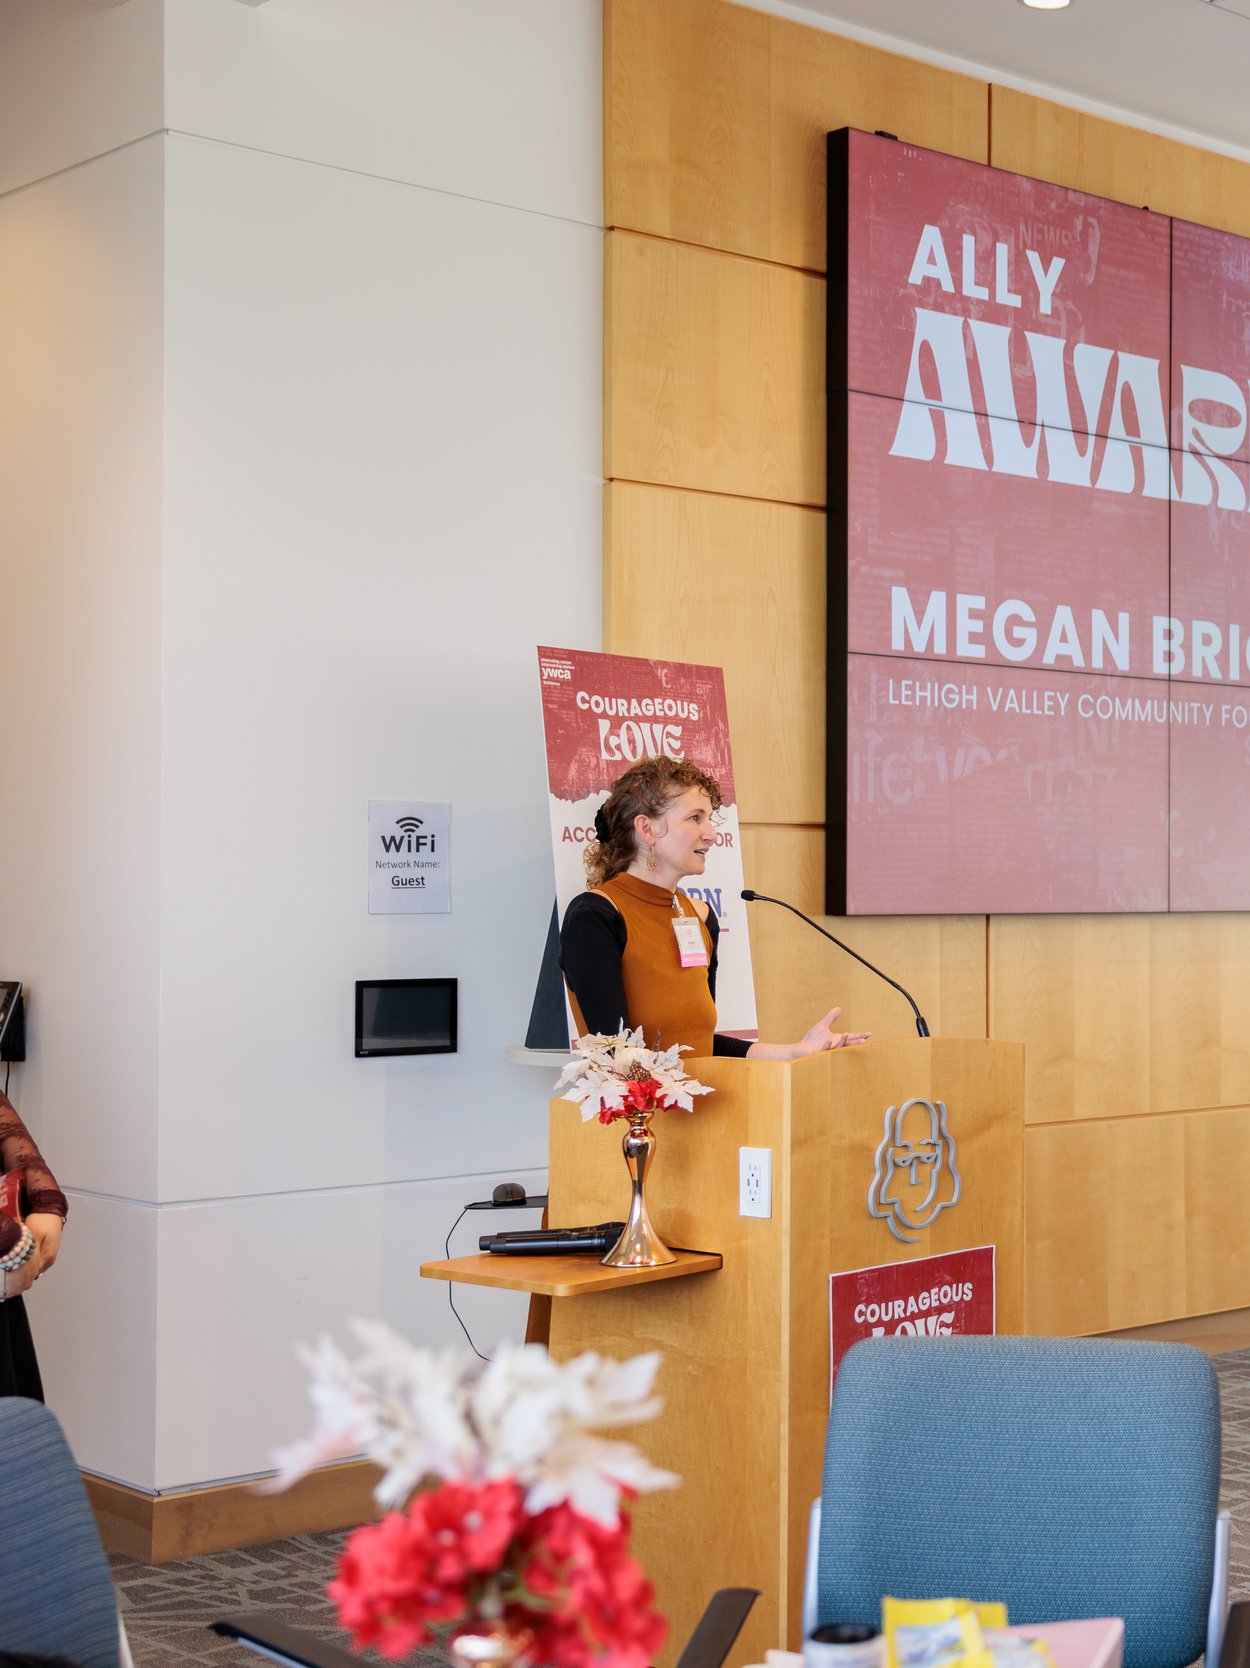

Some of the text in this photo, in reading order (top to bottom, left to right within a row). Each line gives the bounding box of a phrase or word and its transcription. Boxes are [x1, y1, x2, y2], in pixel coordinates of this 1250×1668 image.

[908, 224, 1066, 315] ALLY
[891, 585, 1130, 672] MEGAN
[542, 667, 572, 680] ywca
[576, 691, 699, 721] COURAGEOUS
[888, 678, 977, 710] LEHIGH
[986, 686, 1070, 716] VALLEY
[1077, 694, 1215, 726] COMMUNITY
[597, 718, 685, 763] LOVE
[381, 834, 436, 853] WiFi
[375, 860, 440, 869] Network Name:
[391, 875, 426, 888] Guest
[854, 1282, 974, 1324] COURAGEOUS
